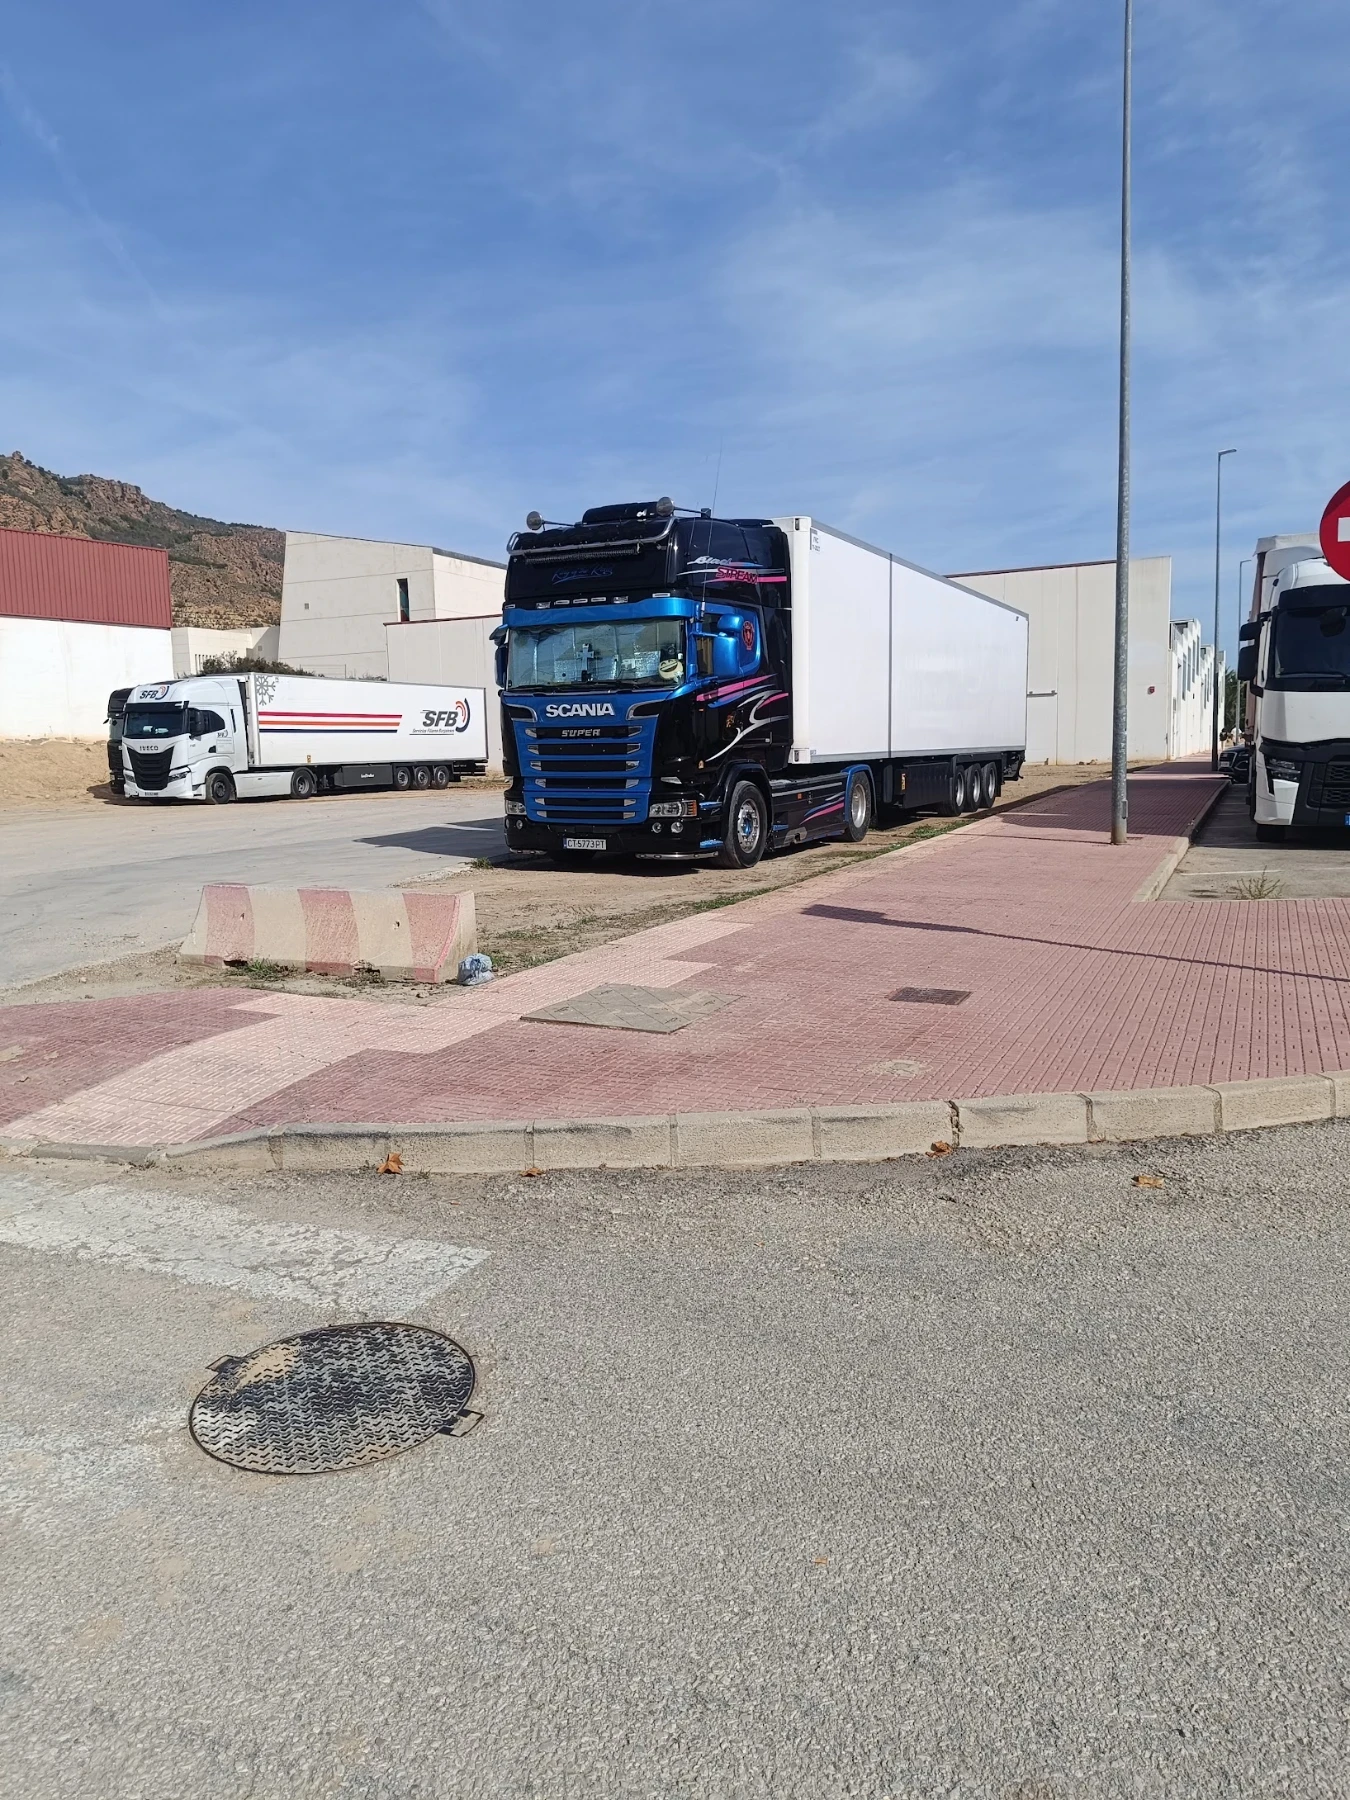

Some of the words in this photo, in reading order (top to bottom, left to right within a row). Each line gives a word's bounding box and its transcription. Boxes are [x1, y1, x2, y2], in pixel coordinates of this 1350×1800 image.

[716, 566, 758, 584] STREAM
[140, 690, 159, 700] SFB
[545, 703, 615, 718] SCANIA
[422, 710, 459, 728] SFB
[561, 728, 601, 737] SUPER
